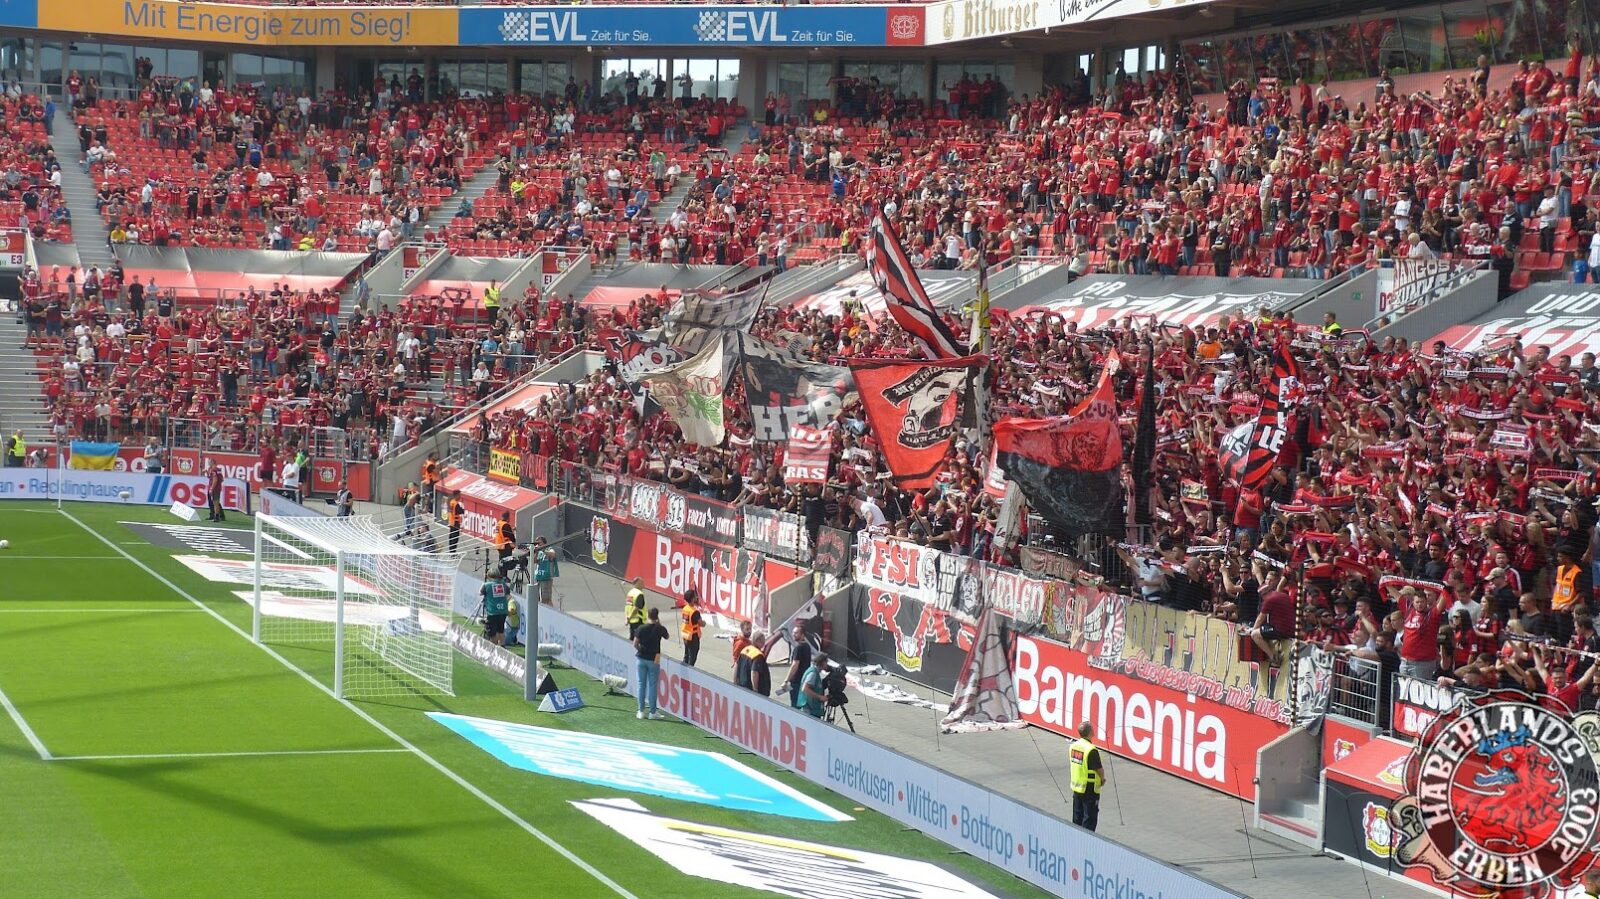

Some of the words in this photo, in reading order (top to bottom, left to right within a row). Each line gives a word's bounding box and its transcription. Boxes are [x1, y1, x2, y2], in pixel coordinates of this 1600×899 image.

[124, 1, 166, 28] Mit
[177, 5, 283, 41] Energie
[290, 17, 340, 36] zum
[350, 11, 411, 42] Sieg!
[530, 11, 587, 42] EVL
[726, 11, 788, 42] EVL
[962, 0, 1039, 37] Bitburger
[591, 30, 612, 42] Zeit
[614, 30, 630, 42] für
[632, 30, 652, 42] Sie.
[791, 30, 815, 42] Zeit
[816, 30, 832, 42] für
[835, 30, 856, 42] Sie.
[11, 255, 23, 265] E3
[786, 465, 826, 480] RAS
[1015, 635, 1227, 783] Barmenia
[657, 668, 807, 773] OSTERMANN.DE
[827, 747, 895, 807] Leverkusen
[905, 780, 948, 831] Witten
[960, 804, 1014, 865] Bottrop
[1028, 834, 1067, 886] Haan
